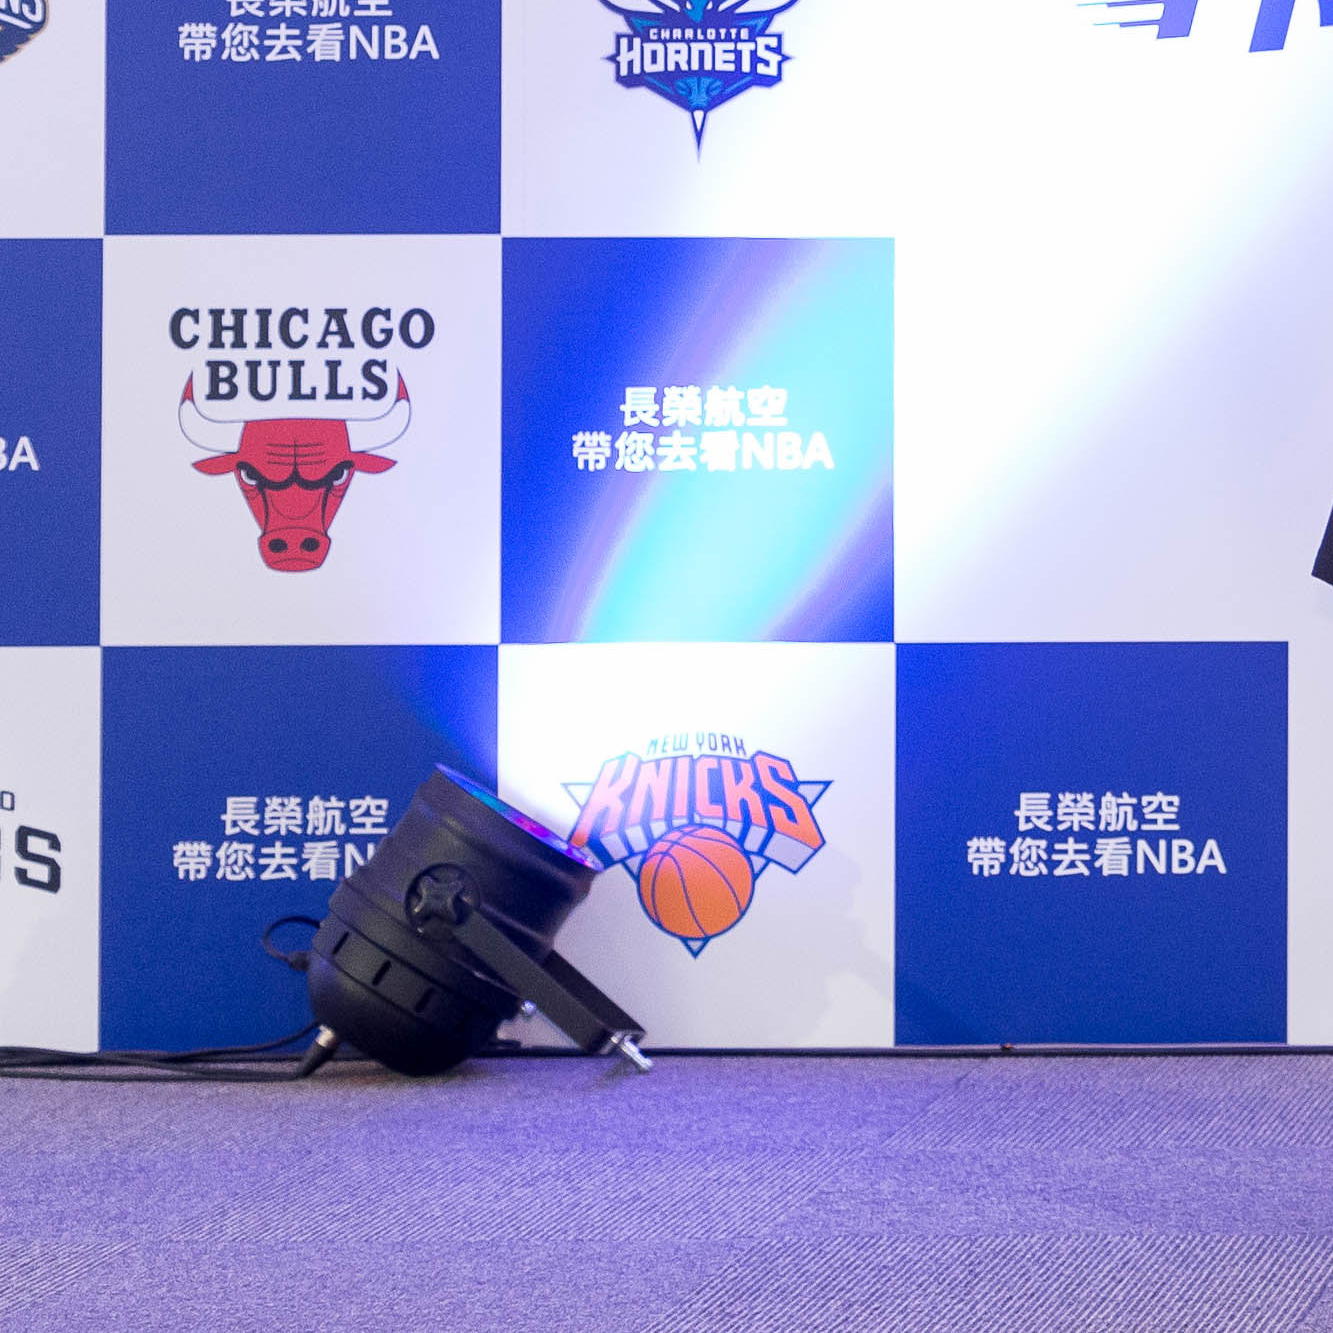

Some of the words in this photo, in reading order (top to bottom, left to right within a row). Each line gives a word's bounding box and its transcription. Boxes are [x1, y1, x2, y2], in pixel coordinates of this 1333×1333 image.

[178, 22, 440, 62] 帶您去看NBA
[649, 27, 749, 41] CHARLOTTE
[616, 36, 783, 77] HORNETS
[169, 307, 437, 351] CHICAGO
[204, 358, 390, 402] BULLS
[695, 731, 748, 757] YORK
[220, 795, 389, 836] 長榮航空
[568, 751, 826, 861] KNICKS
[1013, 791, 1180, 832] 長榮航空
[172, 840, 379, 882] 帶您去看N
[966, 836, 1227, 877] 帶您去看NBA
